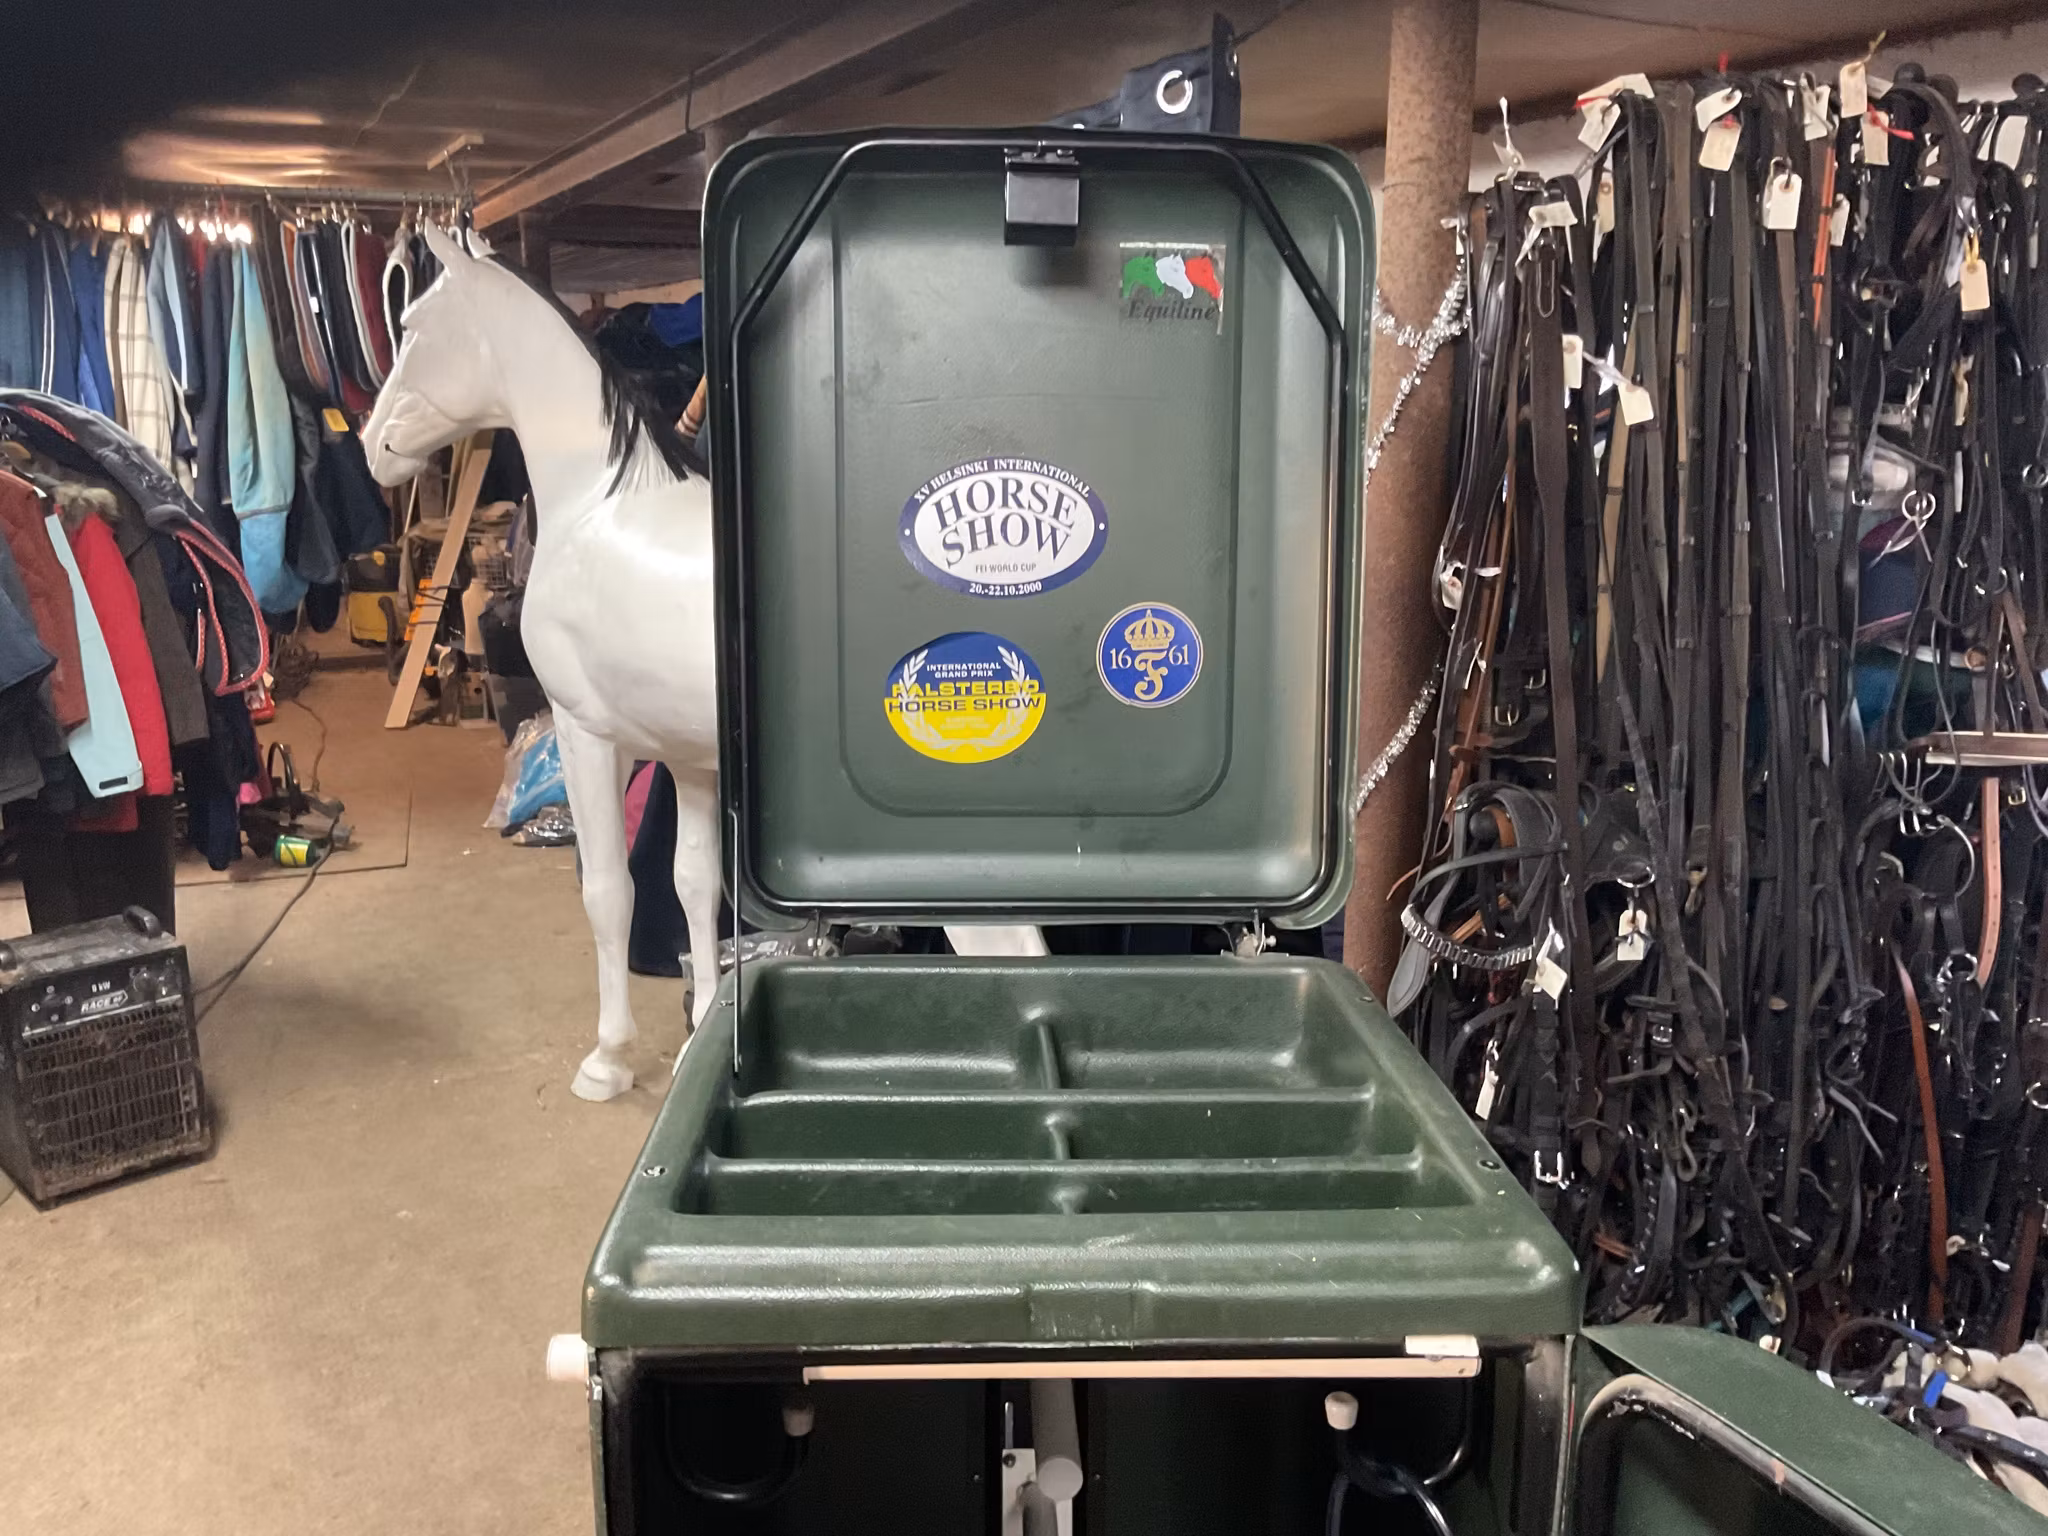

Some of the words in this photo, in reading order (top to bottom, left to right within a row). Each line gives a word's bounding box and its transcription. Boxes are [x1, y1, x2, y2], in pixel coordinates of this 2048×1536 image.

[1127, 299, 1216, 322] Equiline
[914, 485, 931, 503] XV
[930, 460, 989, 491] HELSINKI
[993, 458, 1092, 498] INTERNATIONAL
[931, 476, 1078, 534] HORSE
[941, 512, 1071, 569] SHOW
[975, 564, 987, 574] FEI
[989, 563, 1018, 574] WORLD
[1020, 563, 1037, 572] CUP
[969, 581, 1042, 596] 20.-22.10.2000
[926, 662, 1001, 672] INTERNATIONAL
[934, 670, 968, 679] GRAND
[971, 669, 993, 678] PRIX
[888, 698, 967, 713] HORSE
[973, 697, 1041, 711] SHOW
